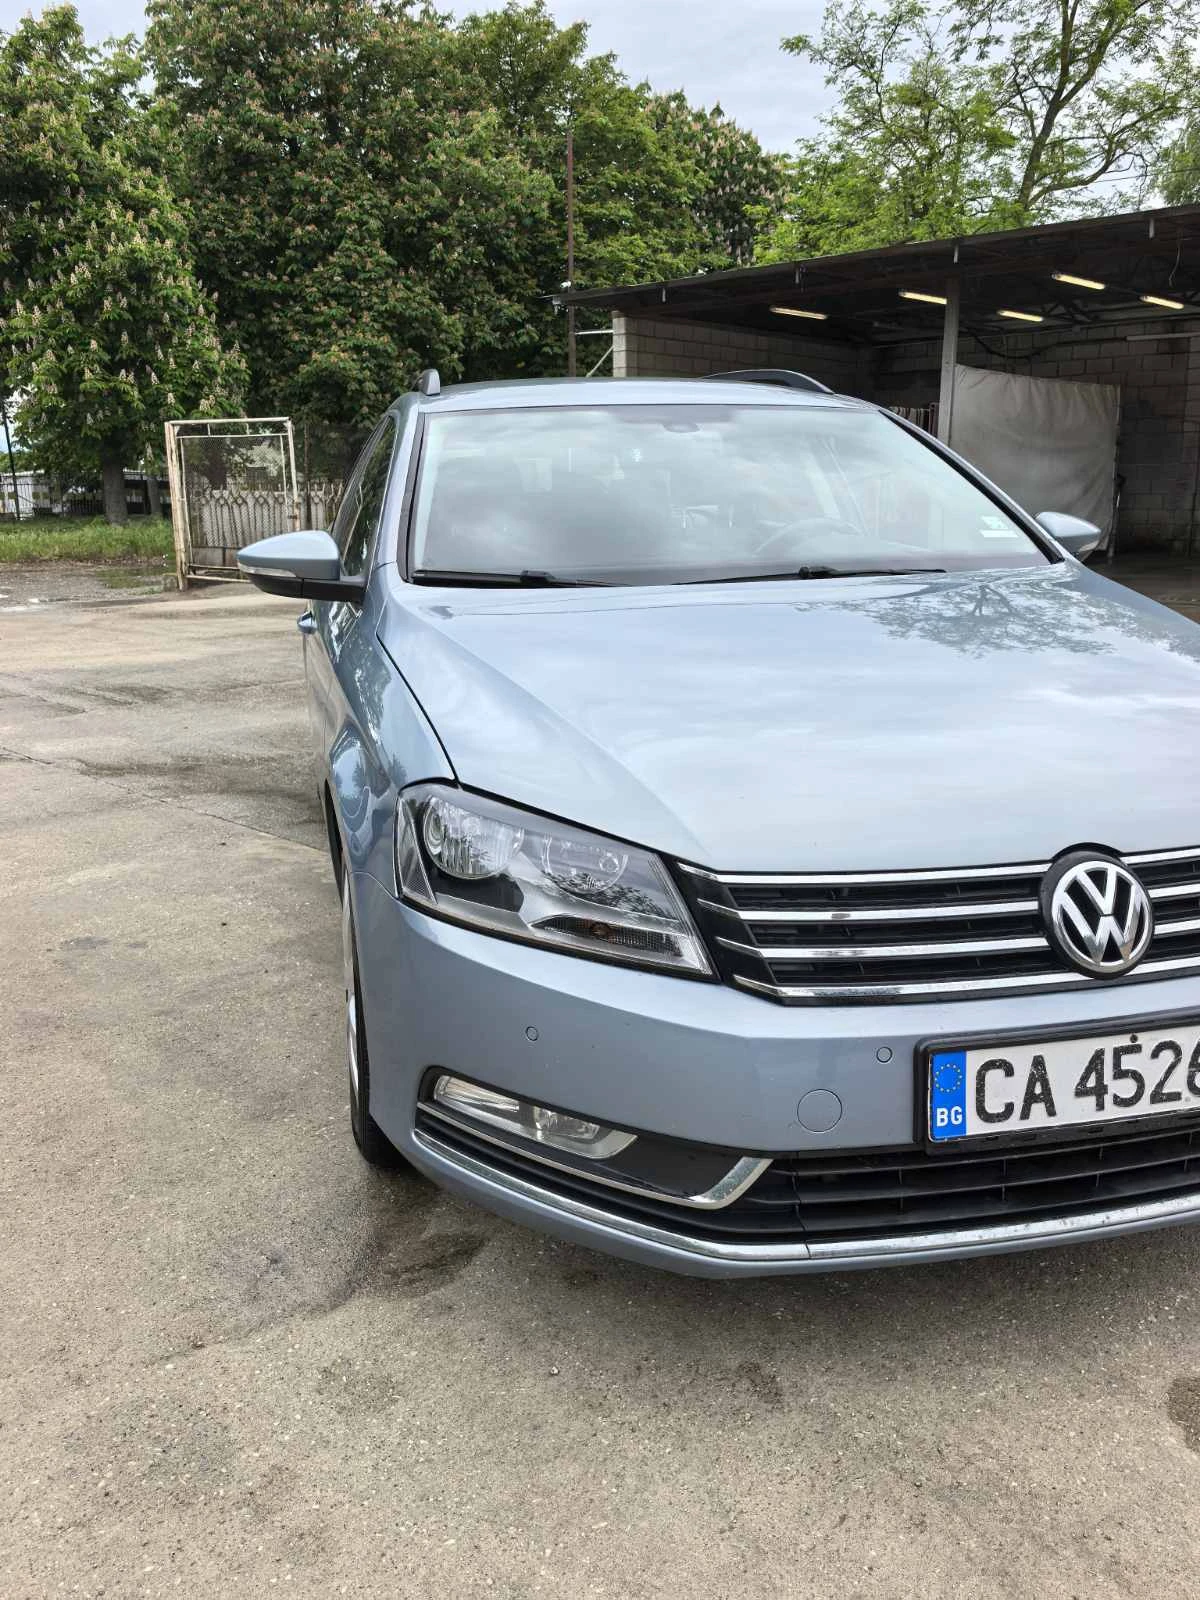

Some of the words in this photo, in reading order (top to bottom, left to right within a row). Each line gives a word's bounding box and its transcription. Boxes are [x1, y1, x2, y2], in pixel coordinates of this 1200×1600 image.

[1055, 863, 1147, 968] VW
[936, 1106, 963, 1127] BG
[975, 1055, 1056, 1123] CA
